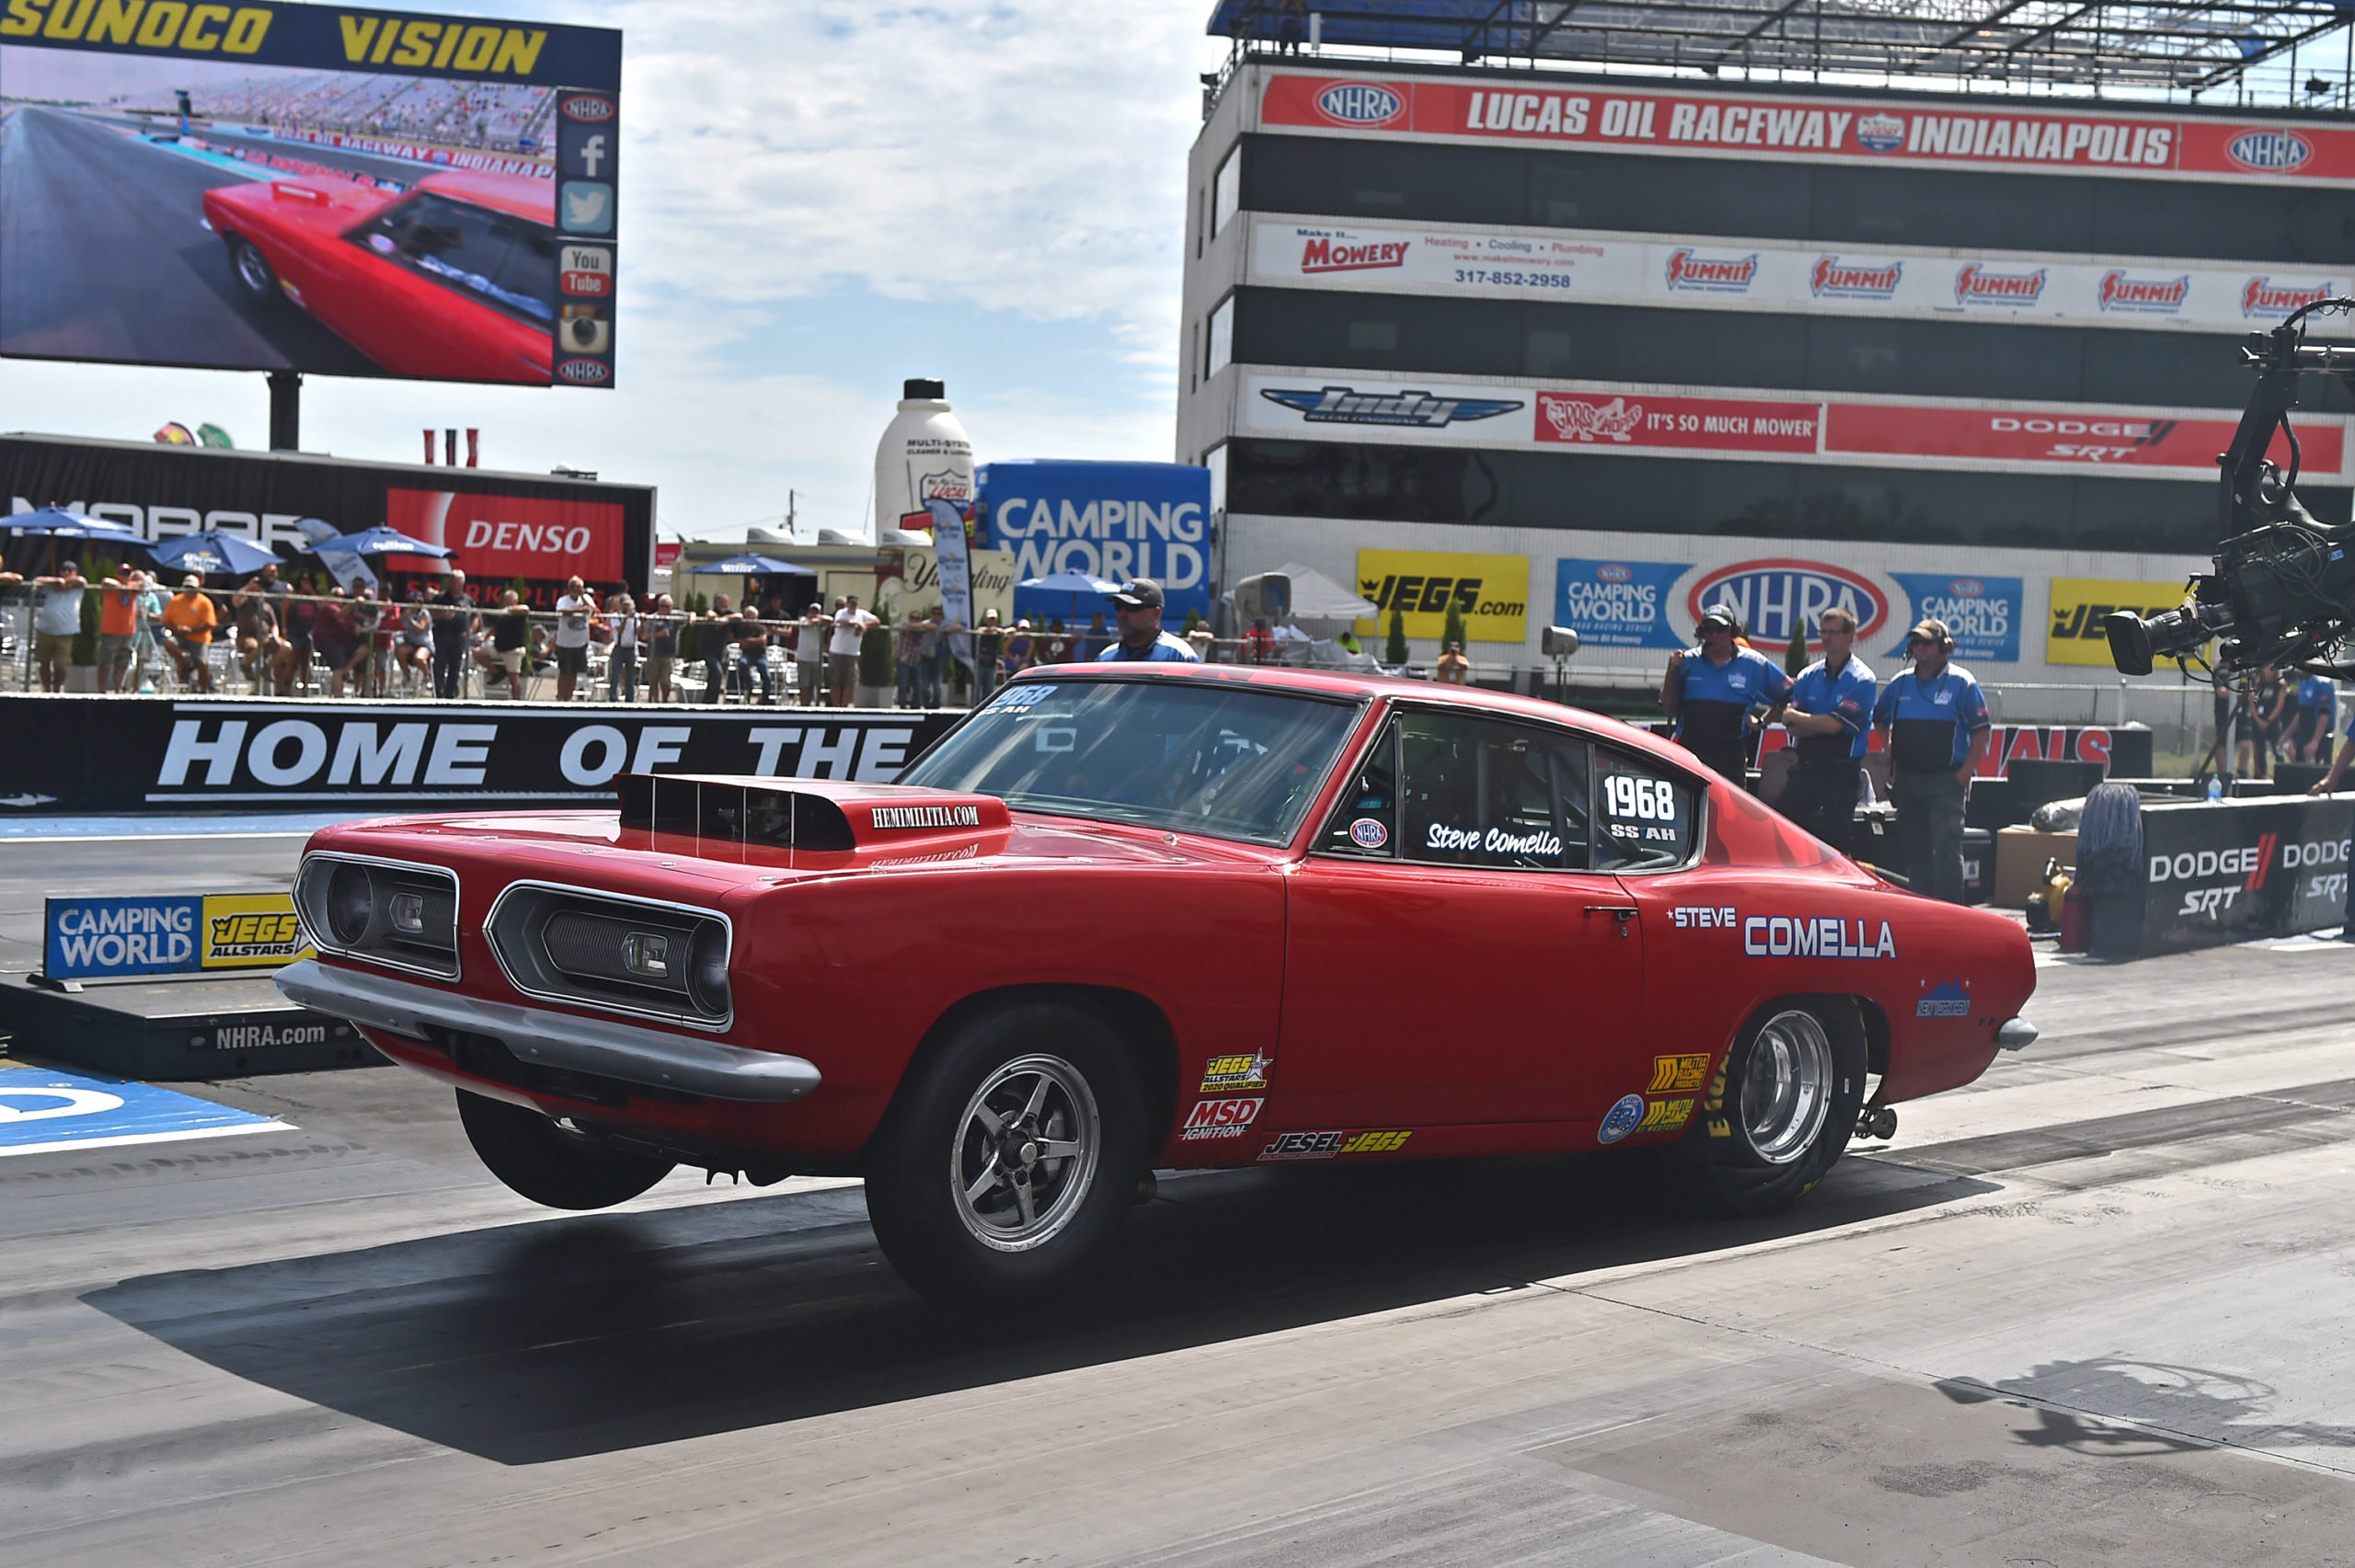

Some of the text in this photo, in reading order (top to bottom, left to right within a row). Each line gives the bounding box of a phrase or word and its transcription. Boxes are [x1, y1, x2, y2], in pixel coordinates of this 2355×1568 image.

[0, 0, 547, 75] SUNOCO VISION
[569, 99, 607, 116] NHRA
[1320, 87, 1394, 121] NHRA
[1466, 91, 1591, 135] LUCAS
[1599, 99, 1657, 139] OIL
[1668, 102, 1854, 149] RACEWAY
[1906, 116, 2173, 166] INDIANAPOLIS
[341, 137, 431, 163] RACEWAY
[2230, 132, 2310, 167] NHRA
[571, 250, 600, 269] You
[1302, 238, 1410, 267] MOWERY
[1425, 236, 1604, 258] Heating Cooling Plumbing
[1454, 269, 1571, 288] 317-852-2958
[1668, 251, 1753, 283] SUMMIT
[1813, 259, 1897, 291] SUMMIT
[568, 273, 602, 292] Tube
[1959, 267, 2041, 297] SUMMIT
[2102, 273, 2185, 304] SUMMIT
[560, 362, 602, 380] NHRA
[1315, 390, 1460, 424] Indy
[1647, 412, 1813, 438] IT'S SO MUCH MOWER
[1991, 418, 2152, 439] DODGE
[2045, 443, 2138, 462] SRT
[996, 498, 1204, 542] CAMPING
[465, 520, 591, 555] DENSO
[998, 539, 1204, 590] WORLD
[1362, 575, 1524, 616] JEGS.com
[1568, 581, 1656, 603] CAMPING
[1568, 600, 1655, 623] WORLD
[1921, 596, 2008, 617] CAMPING
[1000, 705, 1030, 714] AH
[156, 720, 913, 787] HOME OF THE
[1603, 775, 1675, 821] 1968
[871, 806, 980, 829] HEMIMILITIA.COM
[1356, 824, 1382, 842] NHRA
[1427, 823, 1564, 856] Steve Comella
[1610, 823, 1677, 841] SS AH
[2149, 846, 2259, 883] DODGE
[2177, 885, 2243, 921] SRT
[58, 906, 192, 936] CAMPING
[214, 915, 298, 945] JEGS
[1674, 906, 1897, 959] STEVE COMELLA
[58, 933, 193, 967] WORLD
[210, 944, 294, 958] ALLSTARS
[216, 1024, 326, 1050] NHRA.com
[1203, 1073, 1247, 1083] ALLSTARS
[1207, 1056, 1254, 1075] JEGS
[1201, 1081, 1266, 1092] 2020 QUALIFIER
[1188, 1099, 1258, 1127] MSD
[1661, 1110, 1691, 1124] CAMS
[1181, 1125, 1246, 1141] IGNITION
[1264, 1132, 1342, 1154] JESEL
[1339, 1131, 1414, 1153] JEGS
